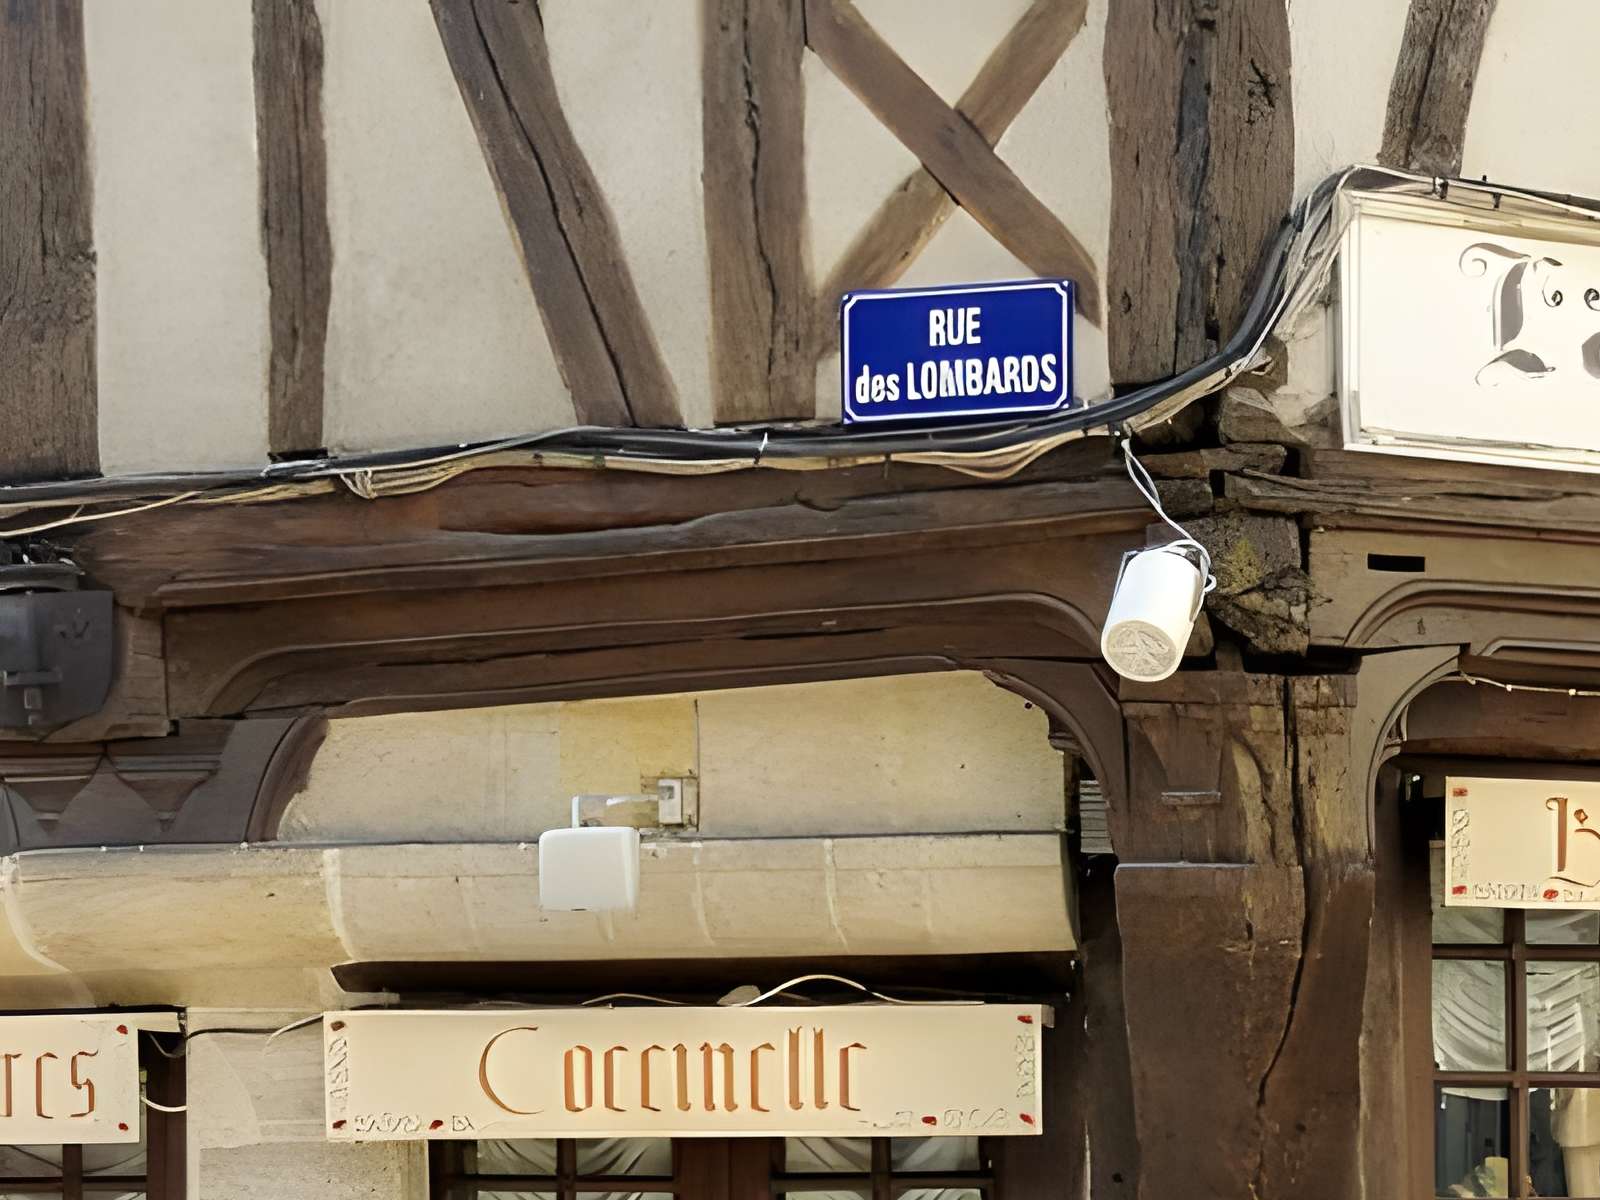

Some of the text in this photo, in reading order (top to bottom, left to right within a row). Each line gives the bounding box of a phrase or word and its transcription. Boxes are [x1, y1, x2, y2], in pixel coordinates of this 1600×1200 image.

[929, 307, 981, 347] RUE
[855, 354, 1057, 404] des LOMBARDS
[478, 1025, 868, 1115] Coccinelle
